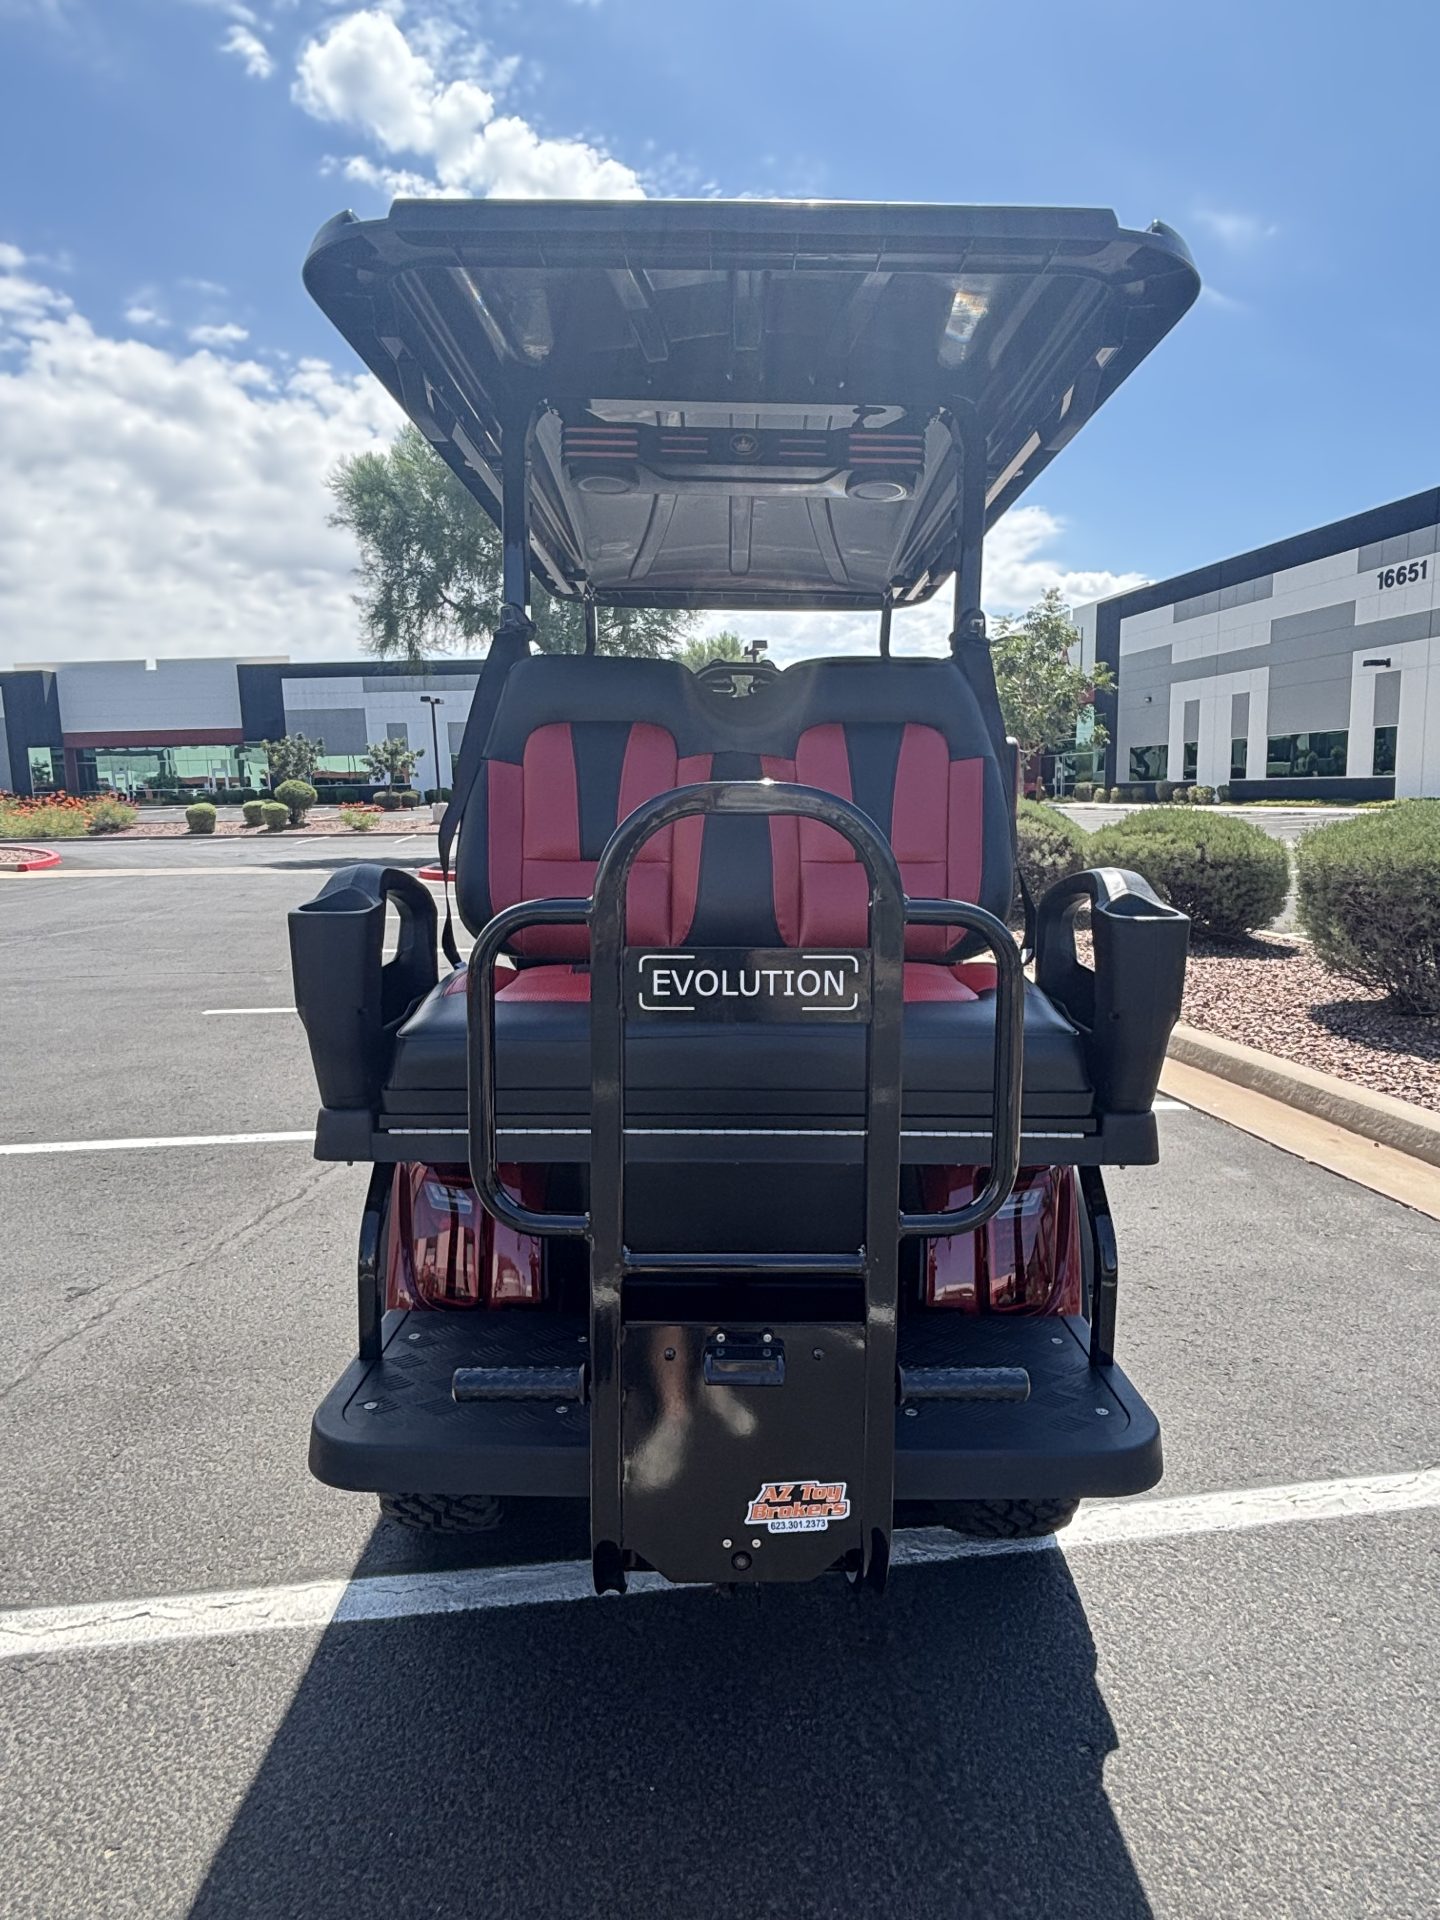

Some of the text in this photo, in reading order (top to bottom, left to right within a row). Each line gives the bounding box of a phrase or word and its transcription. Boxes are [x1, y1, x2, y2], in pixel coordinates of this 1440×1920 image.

[1377, 560, 1428, 590] 16651
[652, 969, 845, 996] EVOLUTION
[759, 1483, 843, 1502] AZ Toy
[750, 1502, 847, 1520] Brokers
[770, 1519, 826, 1530] 623.301.2373
